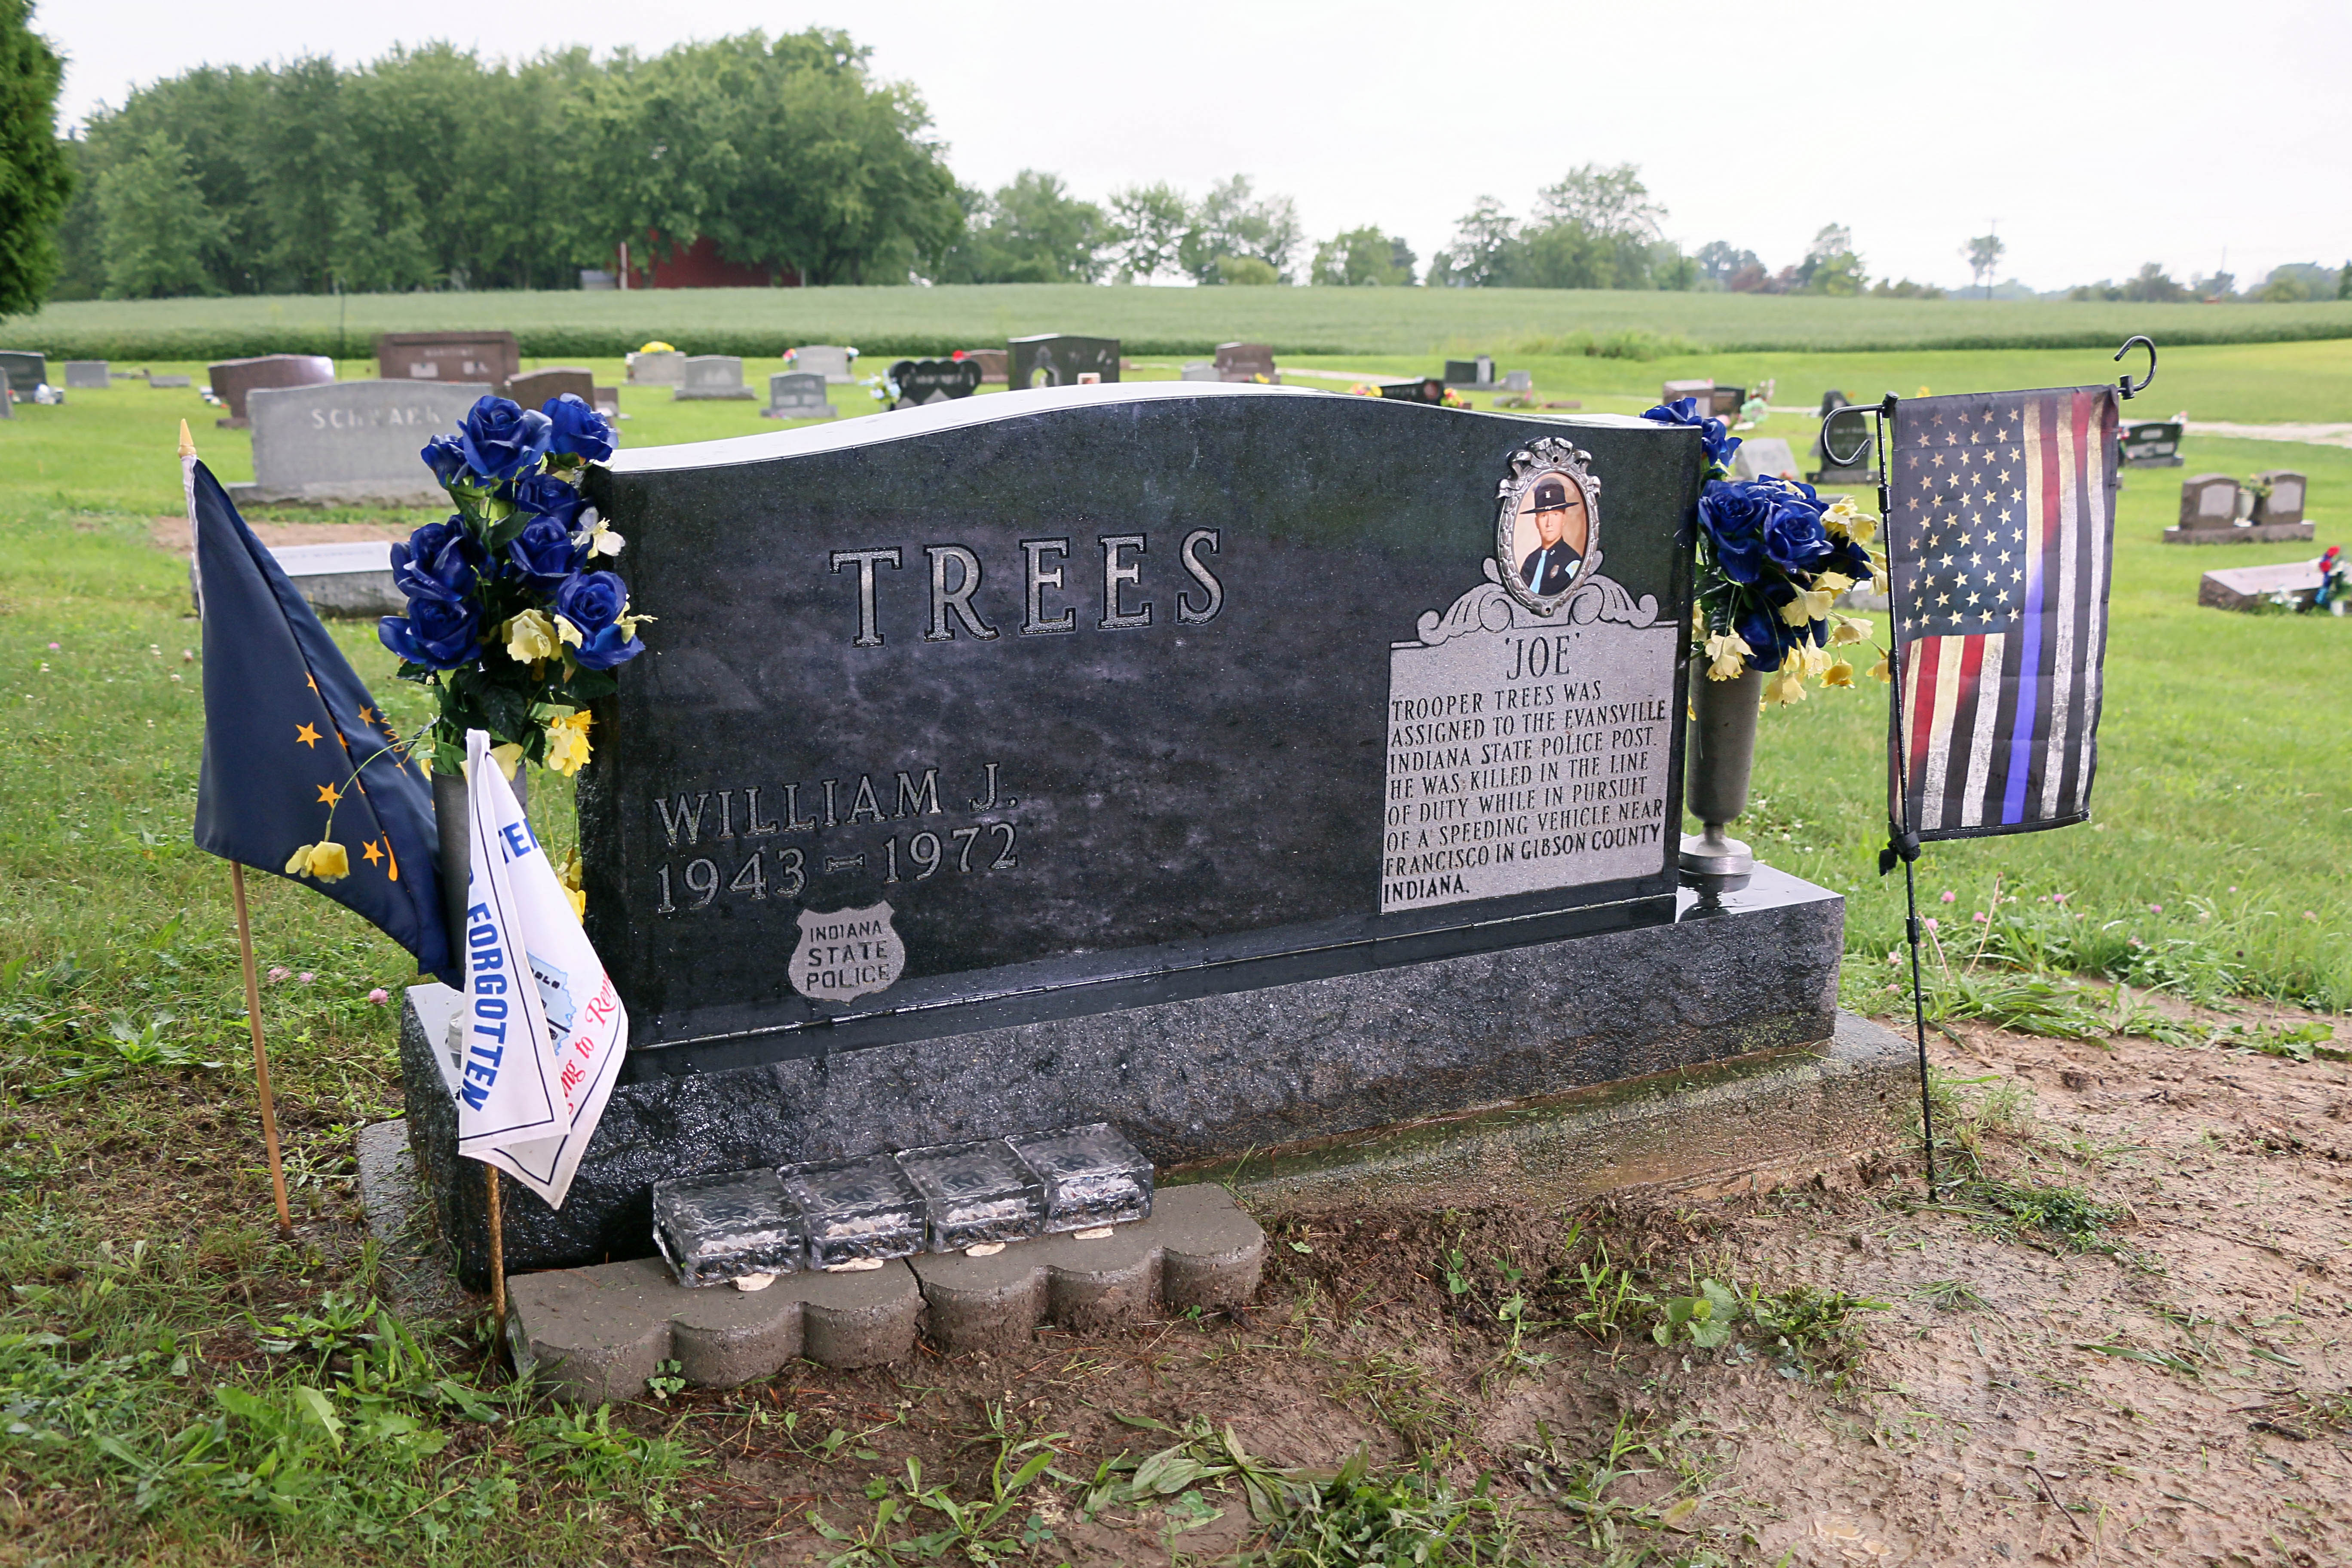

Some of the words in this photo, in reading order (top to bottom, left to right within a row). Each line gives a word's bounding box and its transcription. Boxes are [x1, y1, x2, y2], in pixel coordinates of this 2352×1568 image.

[829, 527, 1225, 648] TREES
[1391, 718, 1485, 748] ASSIGNED
[1493, 715, 1515, 737] TO
[1522, 710, 1555, 733] THE
[1565, 699, 1666, 729] EVANSVILLE
[1392, 692, 1482, 721] TROOPER
[1495, 685, 1554, 711] TREES
[1564, 680, 1601, 702] WAS
[1390, 747, 1471, 774] INDIANA
[1481, 738, 1532, 765] STATE
[1542, 732, 1603, 758] POLICE
[1612, 727, 1657, 750] POST.
[1390, 778, 1413, 800] HE
[1423, 773, 1459, 796] WAS
[1470, 765, 1531, 791] KILLED
[1541, 761, 1559, 783] IN
[1568, 756, 1600, 778] THE
[1610, 751, 1648, 774] LINE
[654, 767, 943, 846] WILLIAM
[968, 761, 1019, 813] J.
[1387, 830, 1409, 852] OF
[1418, 828, 1428, 848] A
[1439, 816, 1528, 846] SPEEDING
[1538, 805, 1609, 831] VEHICLE
[1619, 798, 1663, 821] NEAR
[1388, 805, 1410, 827] OF
[1420, 798, 1469, 822] DUTY
[1479, 790, 1535, 815] WHILE
[1545, 786, 1562, 808] IN
[1573, 776, 1648, 804] PURSUIT
[657, 847, 807, 914] 1943
[883, 822, 1018, 885] 1972
[1385, 845, 1488, 877] FRANCISCO
[1496, 842, 1514, 863] IN
[1521, 834, 1585, 859] GIBSON
[1592, 823, 1660, 850] COUNTY
[1384, 874, 1470, 904] INDIANA.
[808, 940, 887, 967] STATE
[810, 920, 882, 943] INDIANA
[807, 964, 890, 991] POLICE
[461, 902, 508, 1112] FORGOTTEN
[575, 1036, 594, 1059] to
